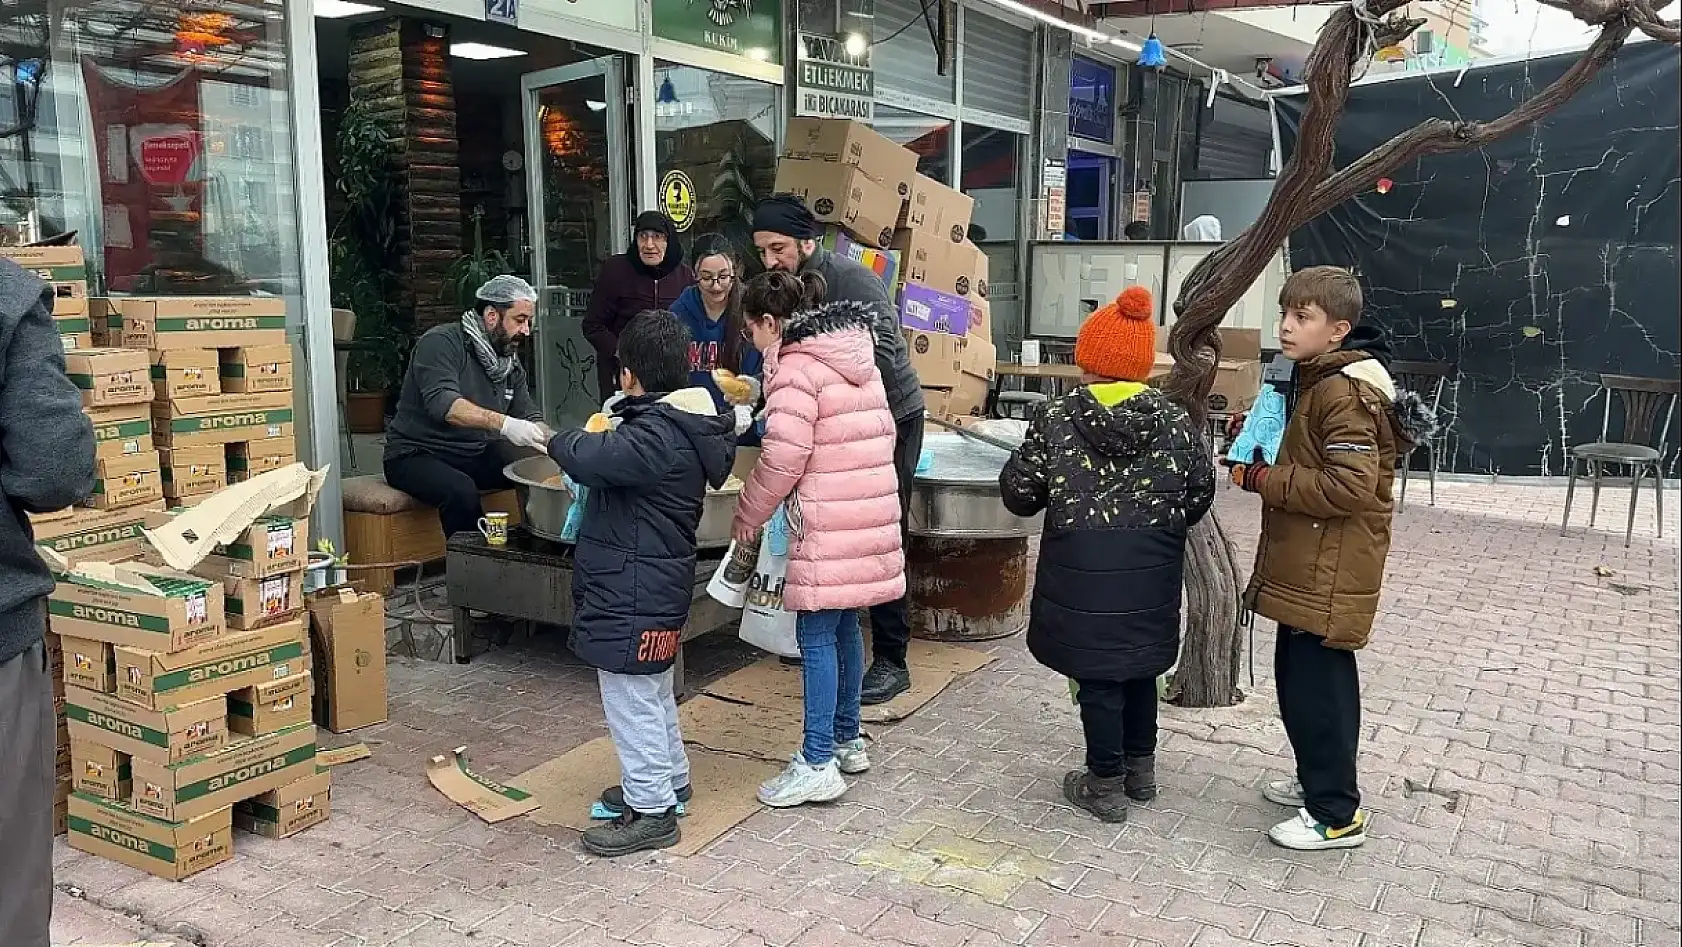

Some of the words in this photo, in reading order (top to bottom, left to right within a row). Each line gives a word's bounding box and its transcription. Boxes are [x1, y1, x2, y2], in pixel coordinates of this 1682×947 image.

[186, 318, 258, 330] aroma
[199, 412, 267, 429] aroma
[55, 525, 135, 552] aroma
[73, 604, 140, 628] aroma
[189, 652, 271, 681] aroma
[88, 711, 142, 739] aroma
[208, 757, 286, 791] aroma
[90, 823, 149, 853] aroma
